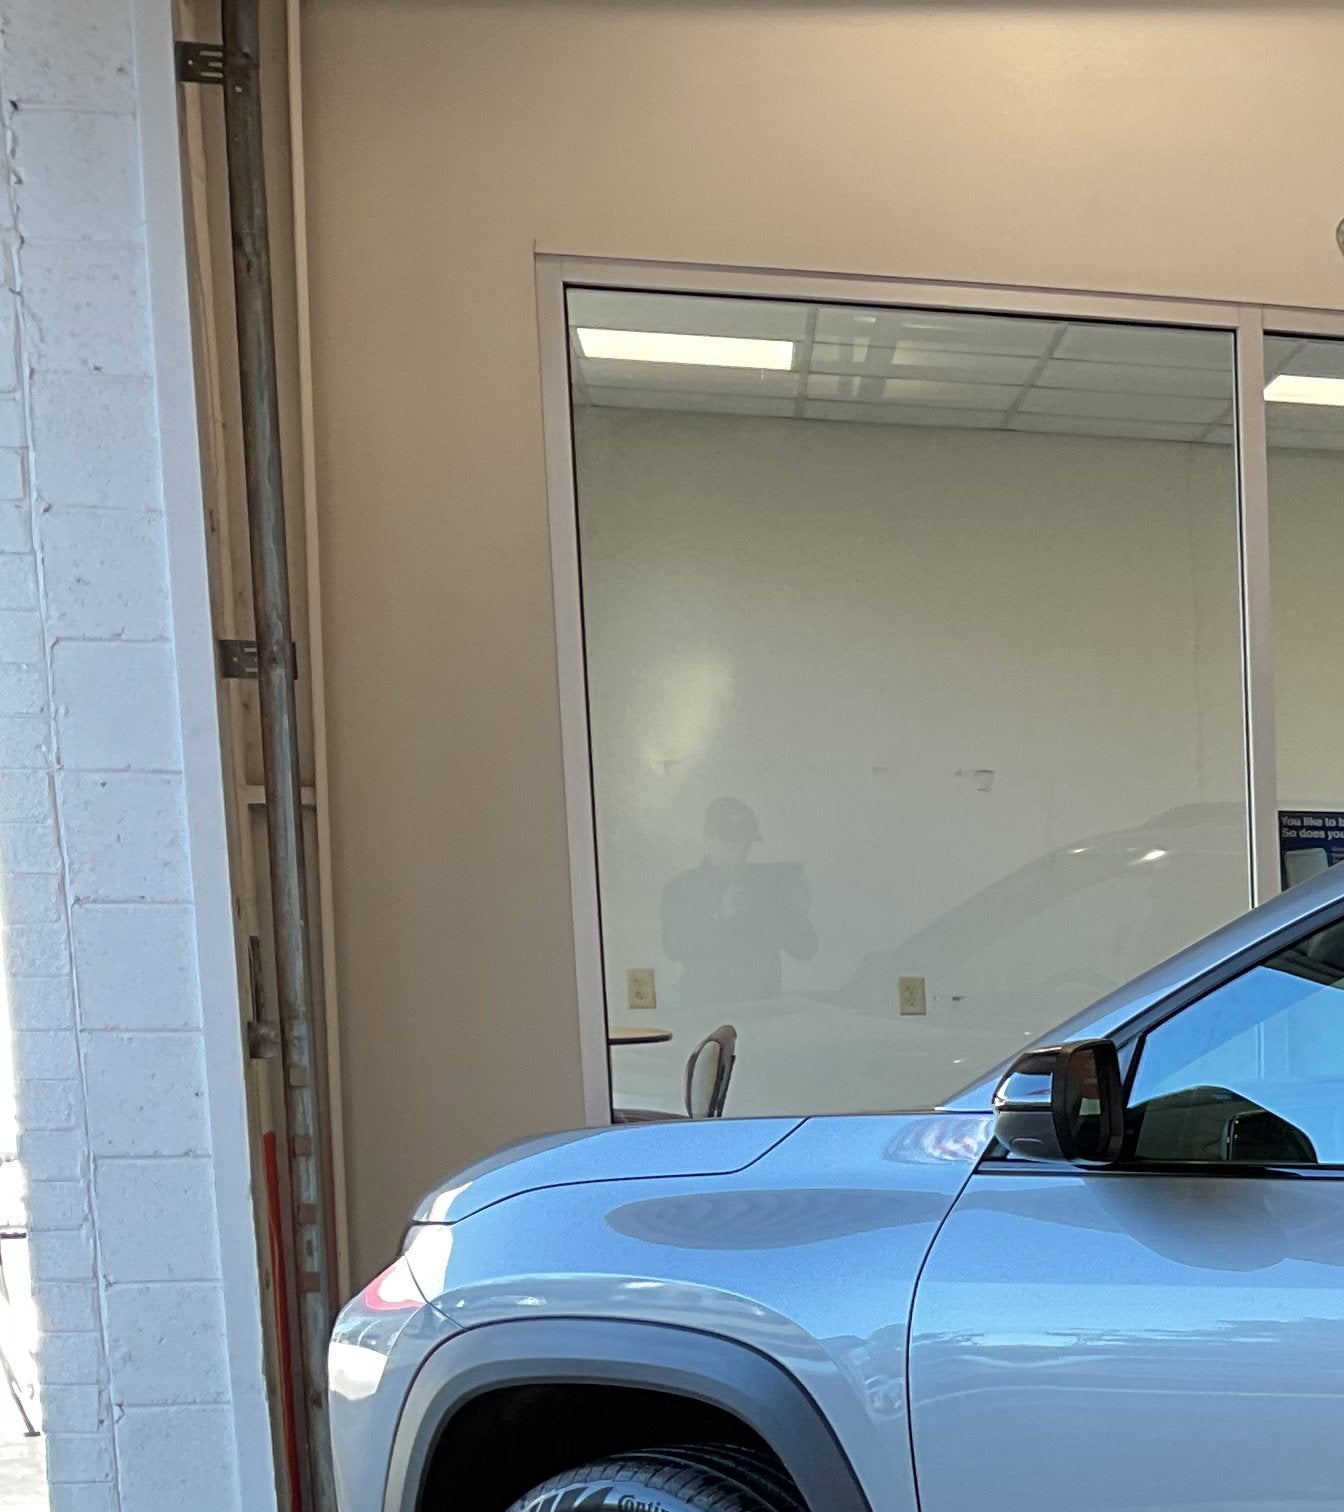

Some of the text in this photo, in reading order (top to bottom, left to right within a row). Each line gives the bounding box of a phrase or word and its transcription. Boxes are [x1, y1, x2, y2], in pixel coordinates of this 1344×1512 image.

[1281, 816, 1300, 827] You
[1303, 817, 1322, 827] like
[1325, 817, 1336, 828] to
[1282, 828, 1297, 838] So
[1299, 829, 1325, 838] does
